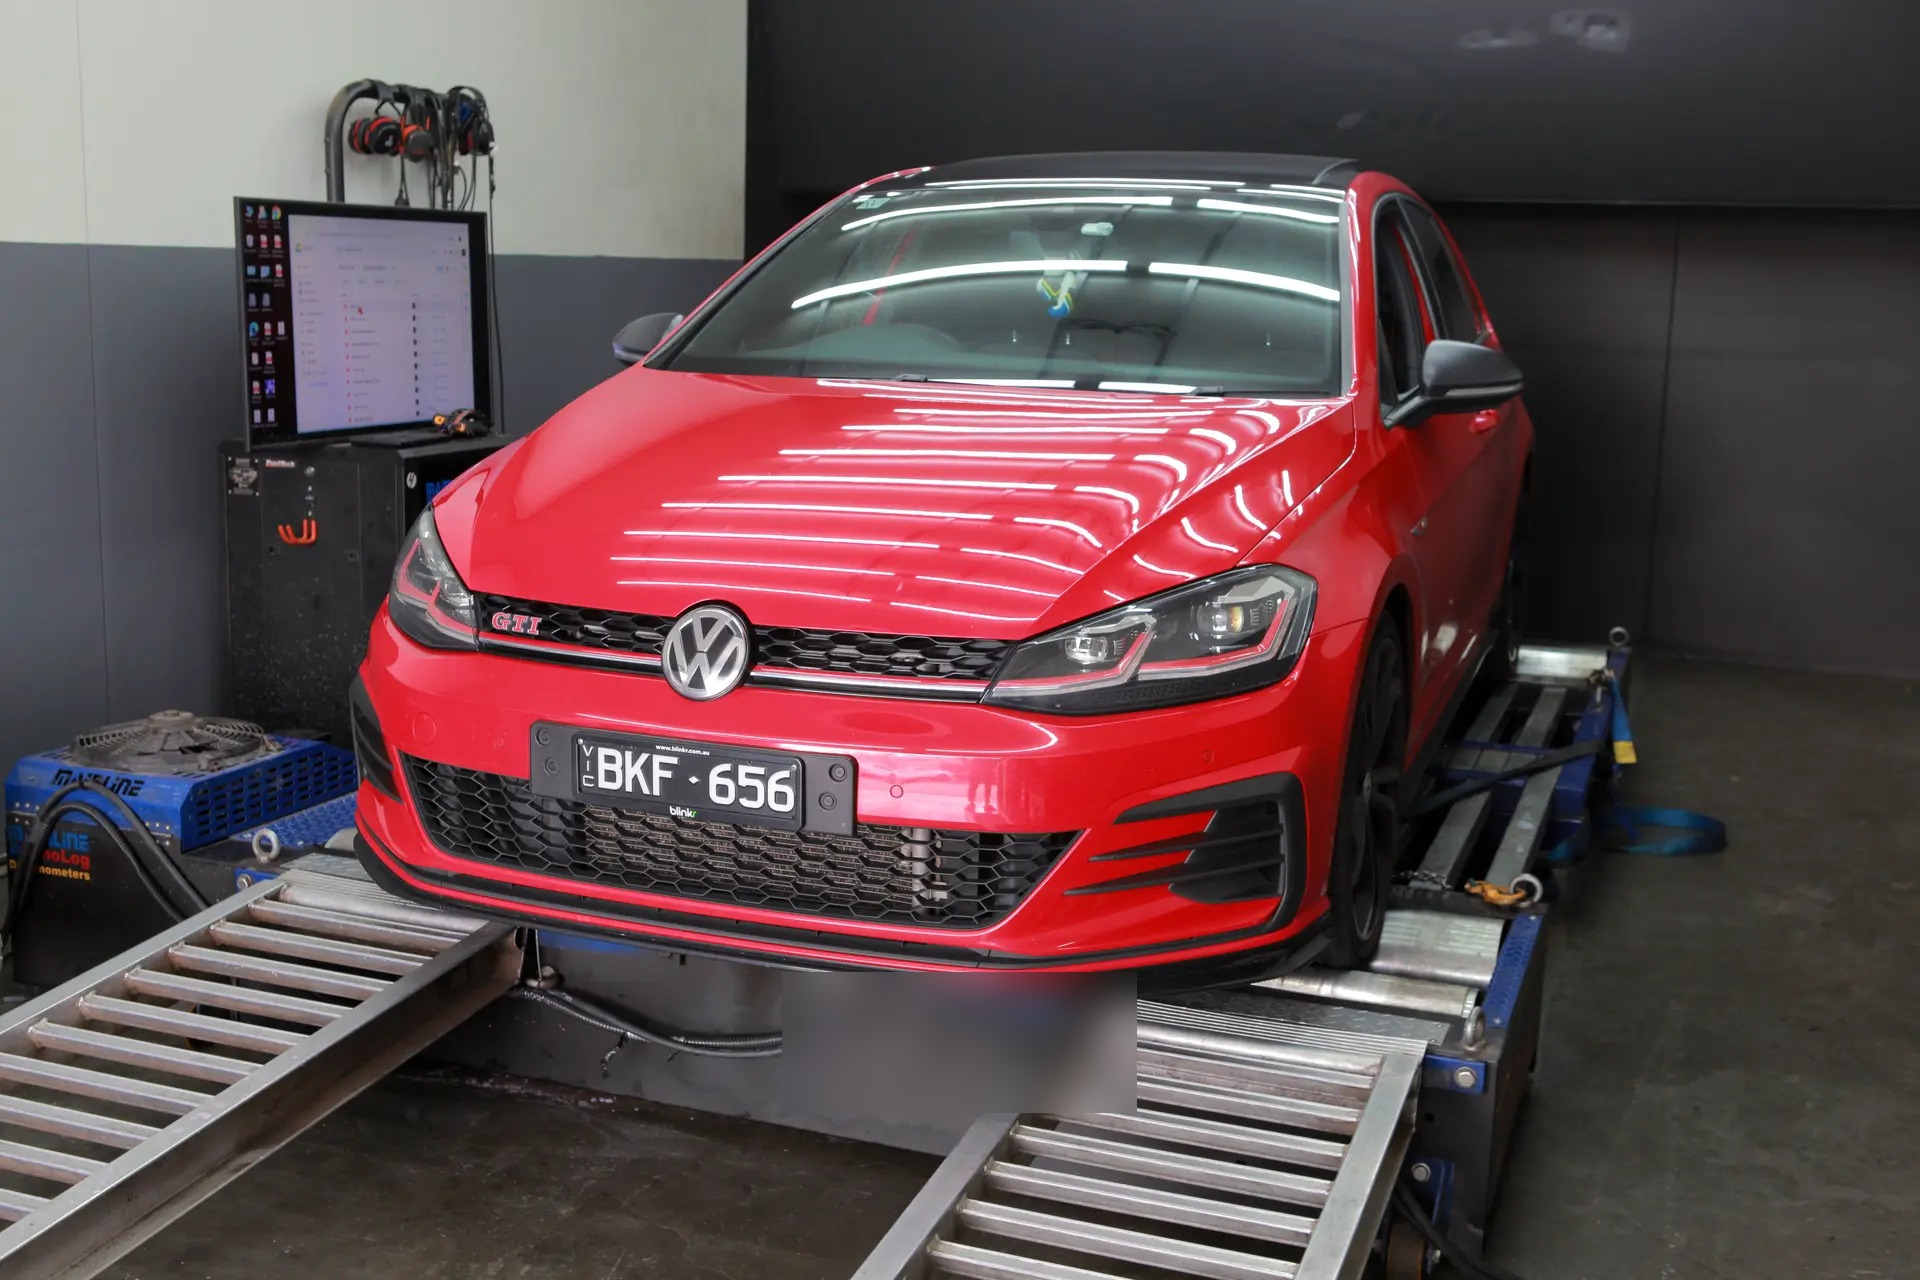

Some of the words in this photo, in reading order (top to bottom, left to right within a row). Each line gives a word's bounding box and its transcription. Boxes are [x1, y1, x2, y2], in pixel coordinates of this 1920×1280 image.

[491, 611, 543, 636] GTI
[655, 744, 710, 756] www.blinkr.com.au
[582, 744, 595, 788] VIC
[597, 746, 679, 797] BKF
[708, 763, 795, 813] 656
[669, 805, 698, 818] blinkr
